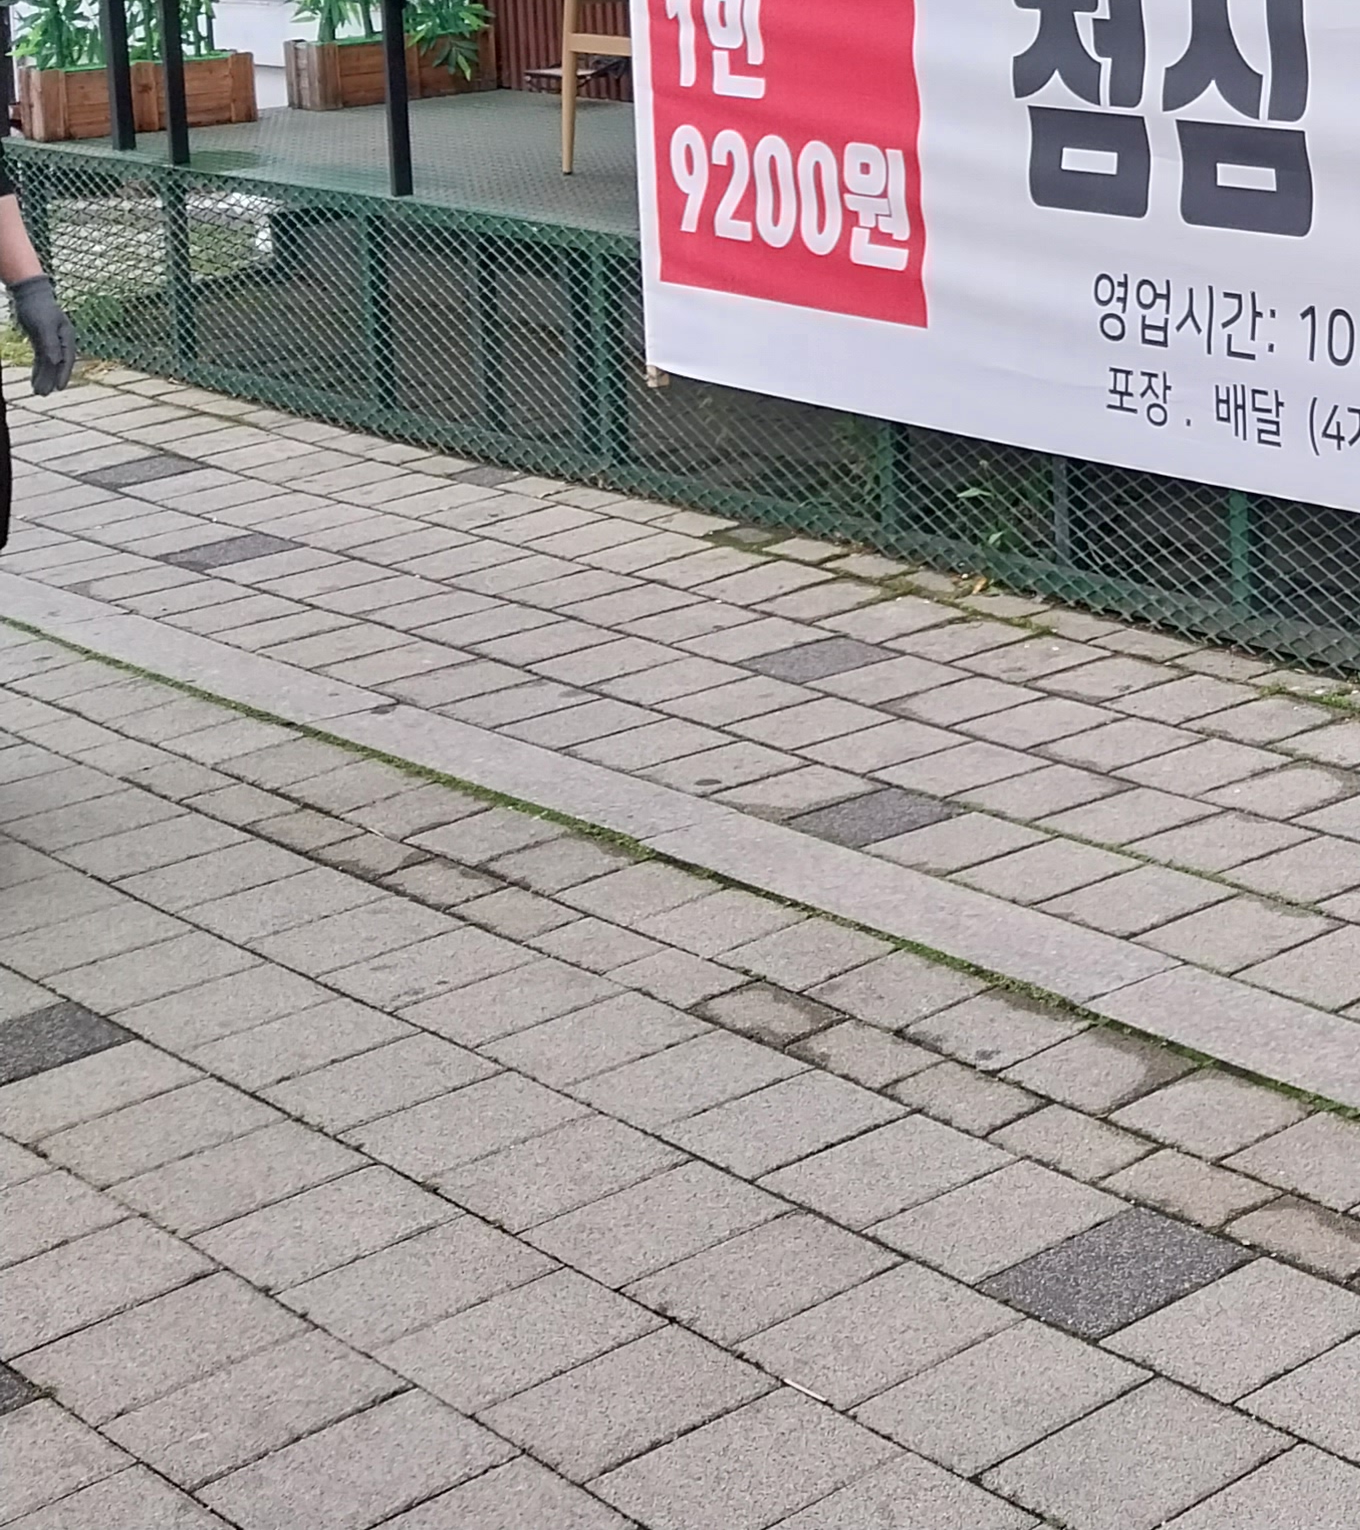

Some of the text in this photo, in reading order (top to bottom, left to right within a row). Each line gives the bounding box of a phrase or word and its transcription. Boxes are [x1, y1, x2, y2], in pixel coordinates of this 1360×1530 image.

[669, 124, 911, 271] 9200원
[1092, 273, 1278, 364] 영업시간:
[1215, 383, 1285, 449] 배달
